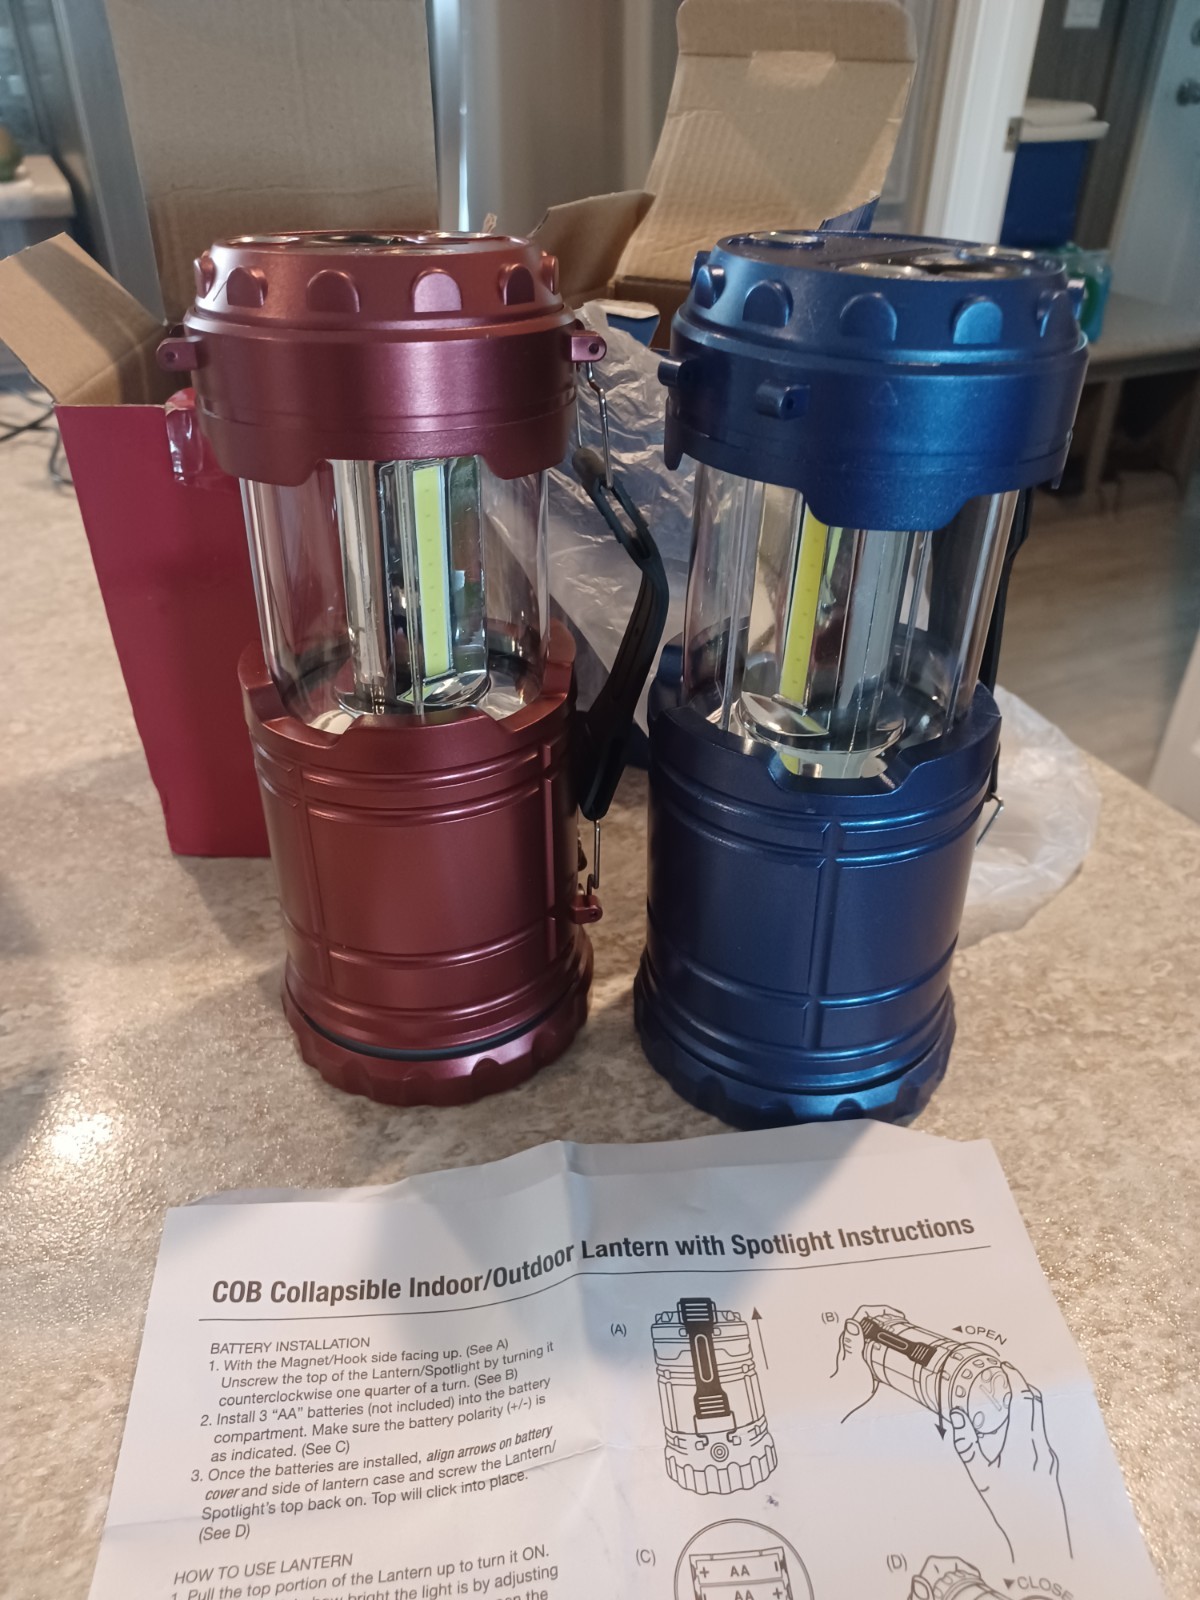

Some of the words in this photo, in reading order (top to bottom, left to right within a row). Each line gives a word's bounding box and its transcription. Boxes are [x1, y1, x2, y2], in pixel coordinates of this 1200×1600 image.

[212, 1280, 262, 1303] COB
[270, 1278, 402, 1307] Collapsible
[409, 1244, 575, 1298] Indoor/Outdoor
[581, 1237, 669, 1260] Lantern
[674, 1234, 726, 1256] with
[731, 1230, 835, 1259] Spotlight
[837, 1218, 975, 1248] Instructions
[610, 1323, 627, 1337] (A)
[821, 1311, 840, 1324] (B)
[210, 1342, 272, 1355] BATTERY
[276, 1337, 370, 1352] INSTALLATION
[964, 1325, 1008, 1346] OPEN
[209, 1360, 219, 1371] 1.
[224, 1359, 253, 1371] With
[257, 1358, 277, 1370] the
[281, 1353, 367, 1370] Magnet/Hook
[371, 1352, 397, 1363] side
[401, 1350, 439, 1362] facing
[443, 1350, 462, 1361] up.
[466, 1344, 493, 1358] (See
[496, 1338, 508, 1351] A)
[221, 1376, 279, 1388] Unscrew
[282, 1373, 303, 1385] the
[306, 1372, 328, 1385] top
[331, 1369, 345, 1382] of
[348, 1369, 368, 1381] the
[372, 1360, 480, 1379] Lantern/Spotlight
[484, 1358, 499, 1370] by
[502, 1347, 543, 1365] turning
[547, 1341, 554, 1353] it
[219, 1388, 333, 1407] counterclockwise
[336, 1388, 361, 1399] one
[364, 1384, 411, 1399] quarter
[414, 1382, 427, 1394] of
[430, 1384, 438, 1393] a
[441, 1380, 470, 1392] turn.
[474, 1374, 502, 1389] (See
[505, 1368, 518, 1381] B)
[200, 1414, 212, 1427] 2.
[217, 1410, 256, 1425] Install
[259, 1409, 267, 1422] 3
[307, 1403, 364, 1418] batteries
[368, 1402, 392, 1417] (not
[397, 1396, 455, 1412] included)
[458, 1393, 482, 1406] into
[485, 1389, 505, 1401] the
[509, 1378, 550, 1396] battery
[214, 1426, 307, 1445] compartment.
[312, 1422, 348, 1436] Make
[352, 1422, 380, 1434] sure
[384, 1419, 405, 1431] the
[409, 1415, 454, 1429] battery
[458, 1406, 503, 1426] polarity
[507, 1397, 532, 1415] (+/-)
[536, 1395, 546, 1405] is
[191, 1469, 203, 1482] 3.
[208, 1468, 245, 1481] Once
[250, 1465, 271, 1478] the
[275, 1461, 334, 1476] batteries
[338, 1460, 359, 1471] are
[363, 1451, 422, 1469] installed,
[426, 1449, 455, 1463] align
[457, 1442, 496, 1458] arrows
[499, 1437, 512, 1450] on
[515, 1426, 553, 1445] battery
[210, 1452, 227, 1462] as
[231, 1444, 297, 1461] indicated.
[301, 1442, 331, 1459] (See
[335, 1440, 350, 1455] C)
[205, 1488, 240, 1501] cover
[241, 1483, 268, 1498] and
[272, 1481, 301, 1495] side
[304, 1479, 319, 1492] of
[322, 1477, 369, 1491] lantern
[373, 1474, 405, 1486] case
[409, 1467, 434, 1482] and
[438, 1464, 477, 1479] screw
[481, 1459, 502, 1471] the
[505, 1440, 556, 1467] Lantern/
[280, 1501, 303, 1515] top
[308, 1496, 341, 1511] back
[345, 1496, 367, 1507] on.
[371, 1491, 397, 1506] Top
[400, 1487, 422, 1501] will
[426, 1484, 457, 1498] click
[461, 1480, 486, 1493] into
[489, 1470, 529, 1491] place.
[199, 1526, 231, 1544] (See
[235, 1524, 250, 1540] D)
[174, 1568, 214, 1585] HOW
[218, 1565, 239, 1580] TO
[244, 1561, 276, 1577] USE
[280, 1553, 353, 1573] LANTERN
[187, 1588, 215, 1600] Pull
[219, 1586, 242, 1600] the
[247, 1585, 271, 1598] top
[275, 1578, 327, 1596] portion
[332, 1573, 347, 1587] of
[351, 1572, 373, 1585] the
[378, 1566, 432, 1583] Lantern
[437, 1564, 455, 1578] up
[459, 1560, 473, 1573] to
[477, 1555, 505, 1569] turn
[510, 1550, 518, 1563] it
[522, 1544, 549, 1561] ON.
[636, 1549, 656, 1567] (C)
[730, 1565, 750, 1577] AA
[886, 1553, 908, 1573] (D)
[395, 1588, 418, 1600] the
[422, 1583, 452, 1600] light
[457, 1581, 469, 1595] is
[473, 1578, 490, 1594] by
[494, 1566, 559, 1588] adjusting
[526, 1589, 548, 1600] the
[734, 1590, 755, 1600] AA
[1016, 1576, 1075, 1600] CLOSE
